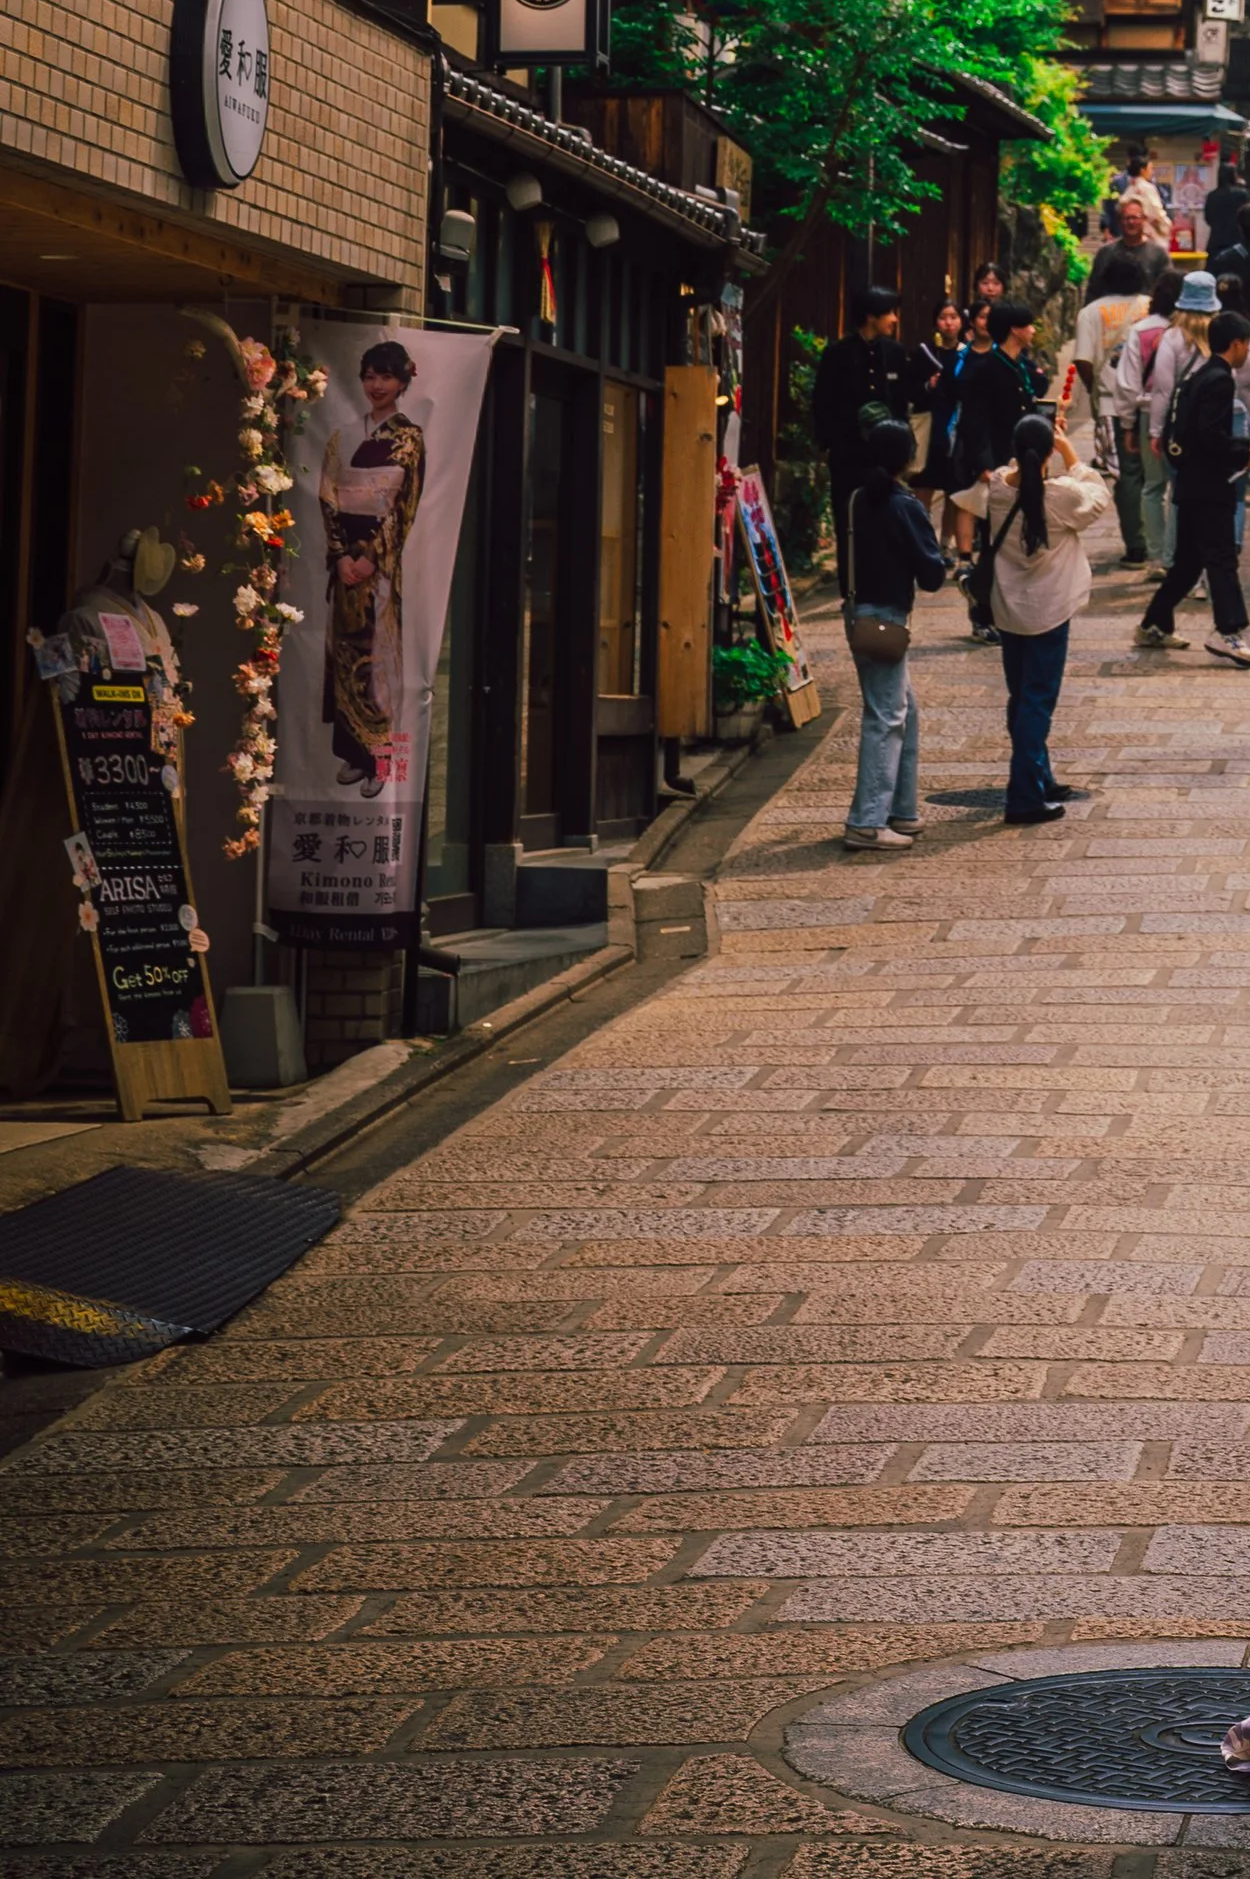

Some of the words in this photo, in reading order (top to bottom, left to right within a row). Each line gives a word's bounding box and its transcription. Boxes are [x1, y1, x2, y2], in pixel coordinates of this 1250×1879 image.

[223, 94, 261, 124] AIWAFUKU
[99, 875, 161, 902] ARISA
[300, 871, 373, 888] Kimono
[112, 965, 143, 990] Get
